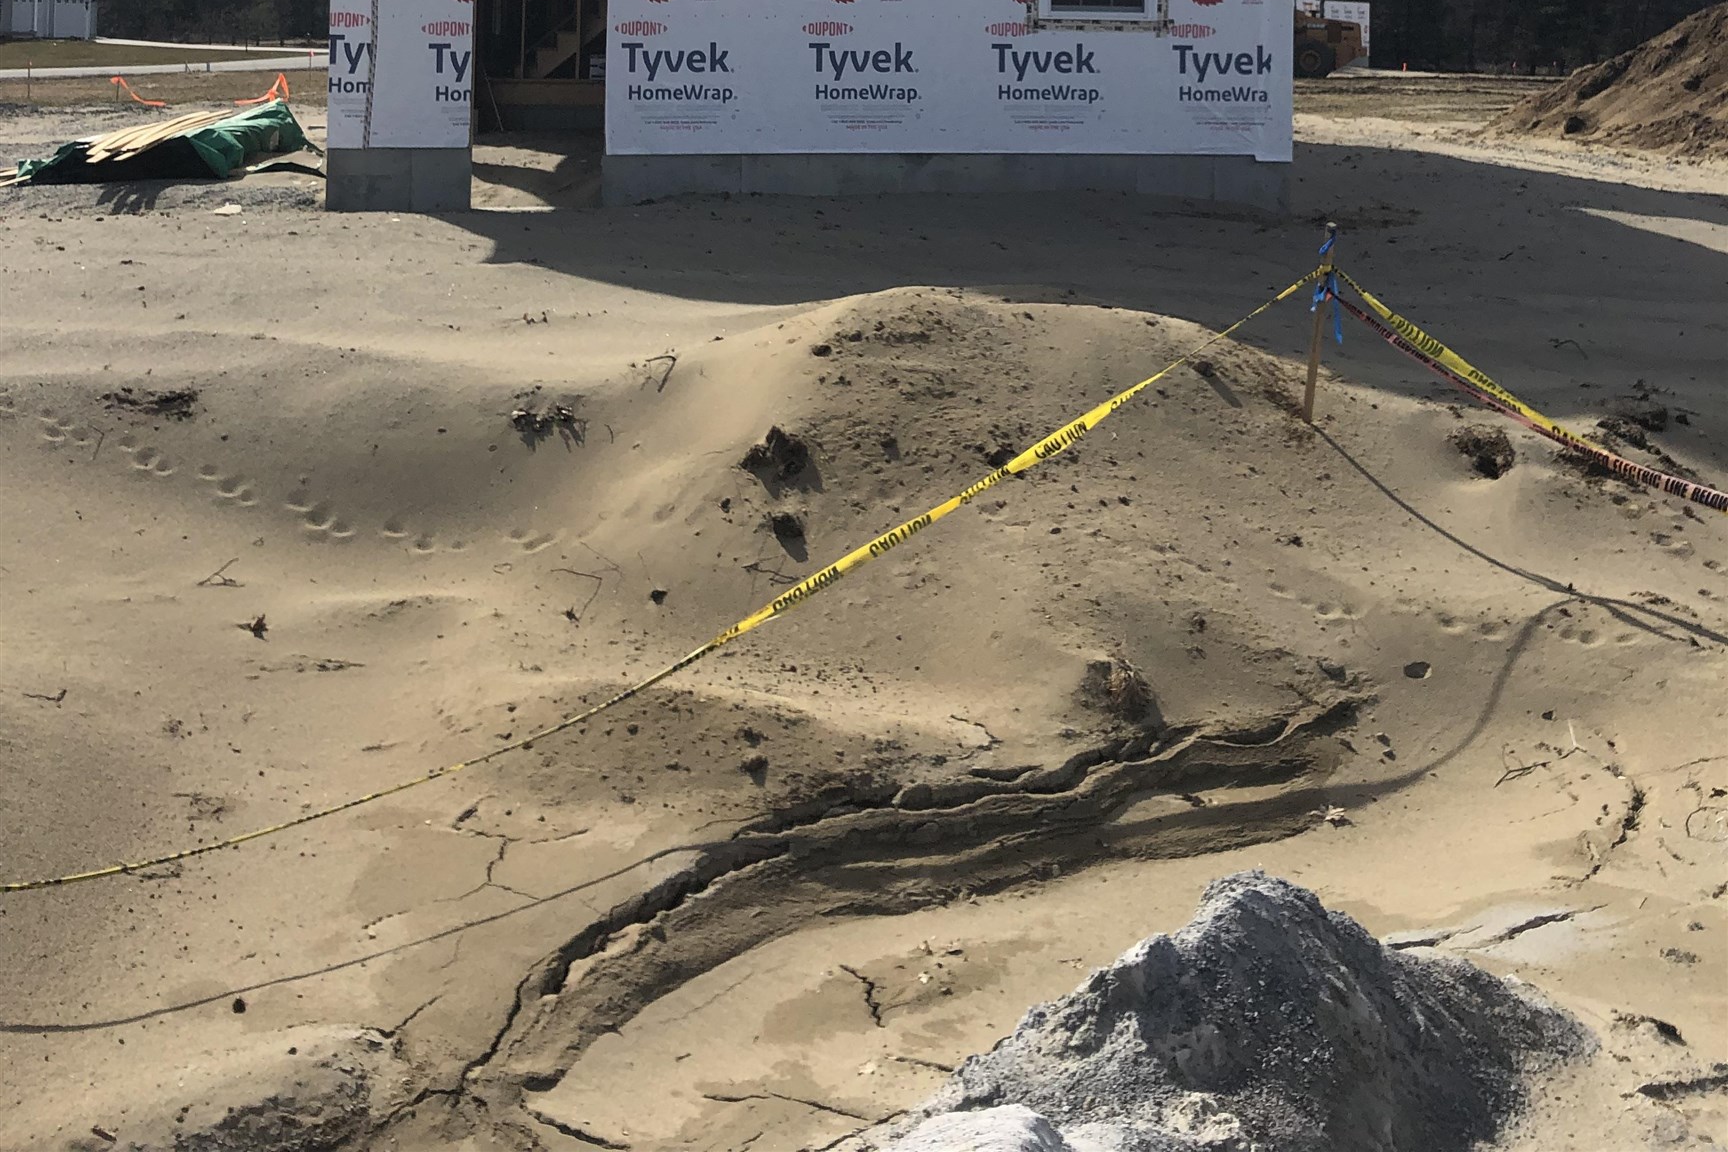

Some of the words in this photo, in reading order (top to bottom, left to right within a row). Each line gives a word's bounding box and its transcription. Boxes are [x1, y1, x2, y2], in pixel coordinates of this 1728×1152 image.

[330, 12, 365, 27] UPONT
[428, 22, 470, 37] DUPONT
[621, 21, 662, 36] DUPONT
[808, 21, 848, 36] DUPONT
[622, 42, 729, 81] Tyvek
[808, 42, 914, 81] Tyvek
[992, 43, 1096, 81] Tyvek
[1179, 86, 1268, 102] HomeWra
